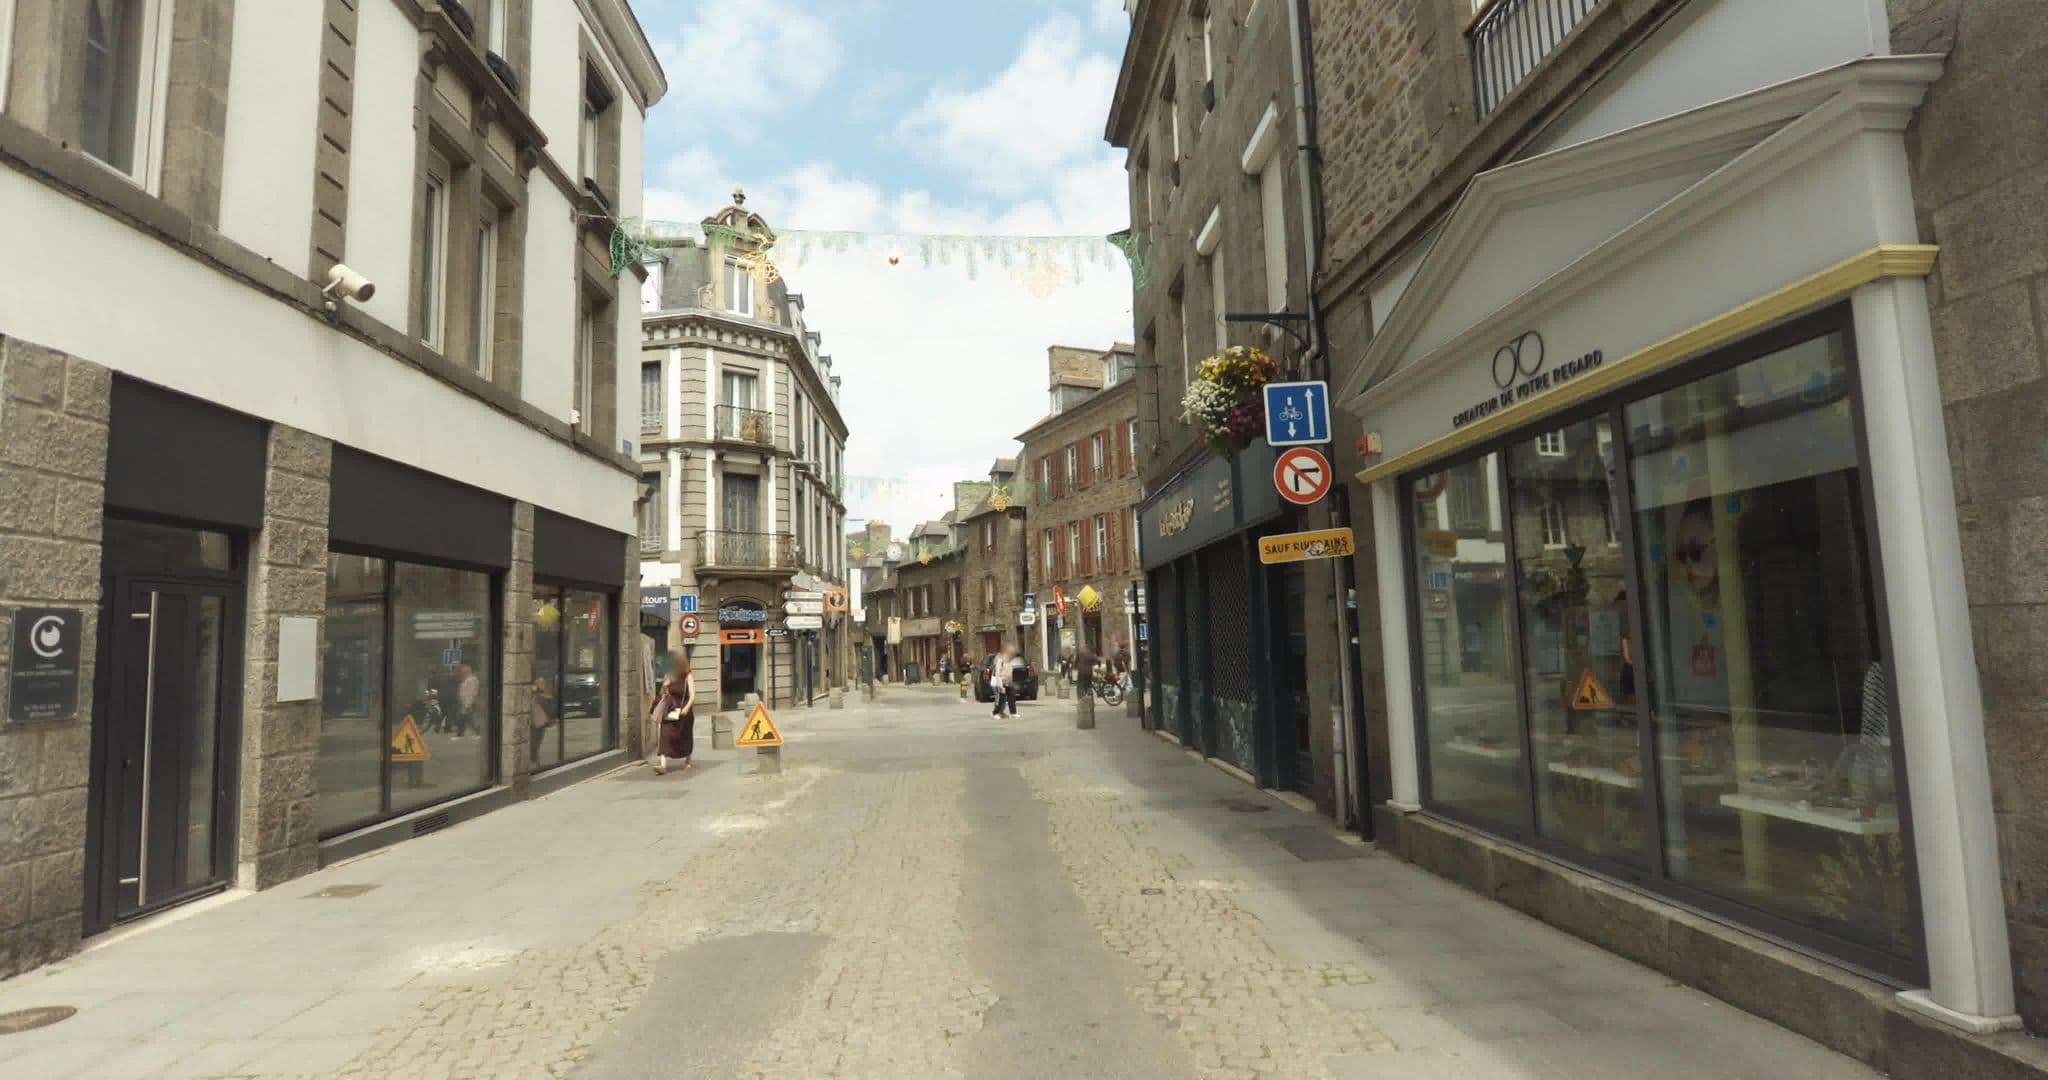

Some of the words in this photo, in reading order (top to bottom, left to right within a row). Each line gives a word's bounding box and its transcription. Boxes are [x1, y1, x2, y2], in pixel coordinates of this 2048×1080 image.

[1453, 396, 1498, 426] CREATEUR
[1500, 389, 1514, 406] DE
[1516, 372, 1550, 397] VOTRE
[1552, 349, 1603, 382] REGARD
[1264, 543, 1291, 554] SAUF
